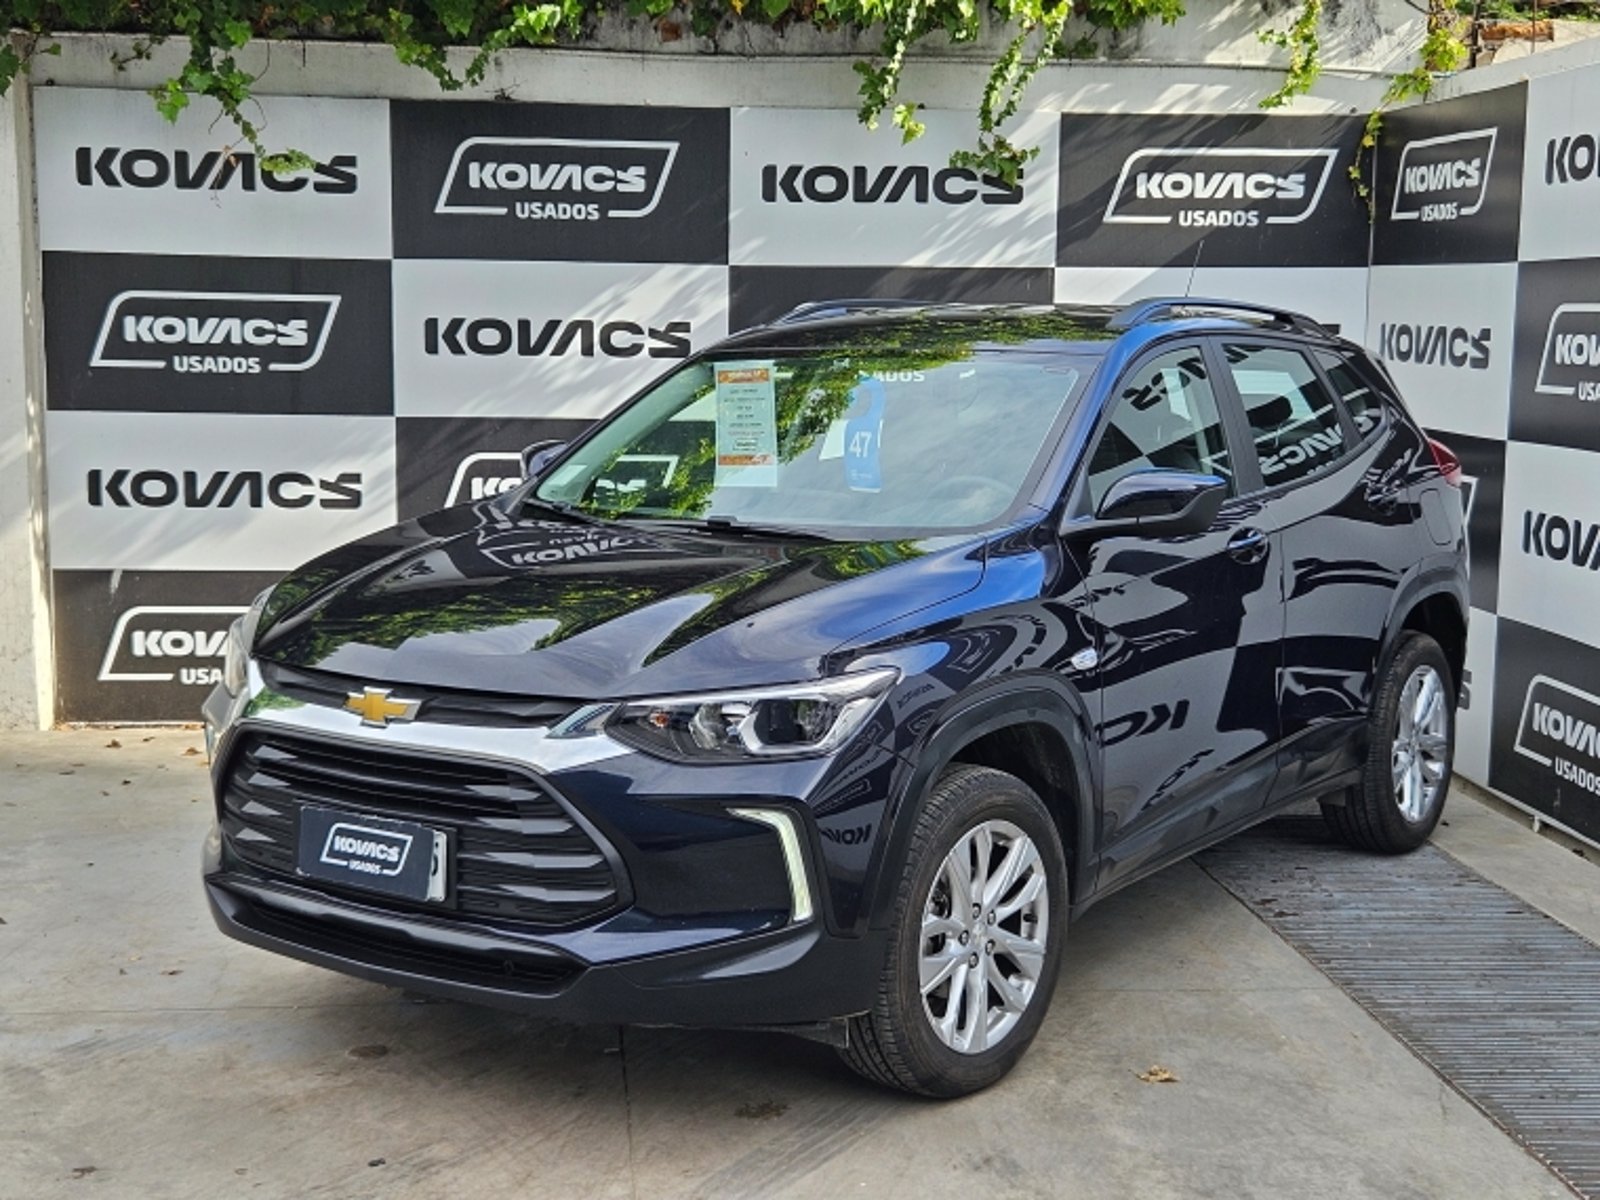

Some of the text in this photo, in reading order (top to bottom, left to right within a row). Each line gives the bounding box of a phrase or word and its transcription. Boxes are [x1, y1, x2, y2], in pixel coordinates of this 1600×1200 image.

[76, 147, 357, 194] KOVACS
[1404, 157, 1481, 194] KOVACS
[1545, 135, 1600, 186] KO
[468, 162, 646, 193] KOVACS
[761, 164, 1024, 204] KOVACS
[1136, 172, 1305, 199] KOVACS
[515, 201, 600, 221] USADOS
[1178, 210, 1258, 227] USADOS
[1421, 203, 1458, 222] USADOS
[123, 315, 308, 346] KOVACS
[424, 317, 691, 358] KOVACS
[1380, 323, 1491, 369] KOVACS
[173, 354, 261, 374] USADOS
[849, 431, 872, 458] 47
[88, 469, 362, 509] KOVACS
[132, 630, 229, 657] KOV
[1532, 702, 1600, 758] KOVA
[333, 835, 401, 862] KOVACS
